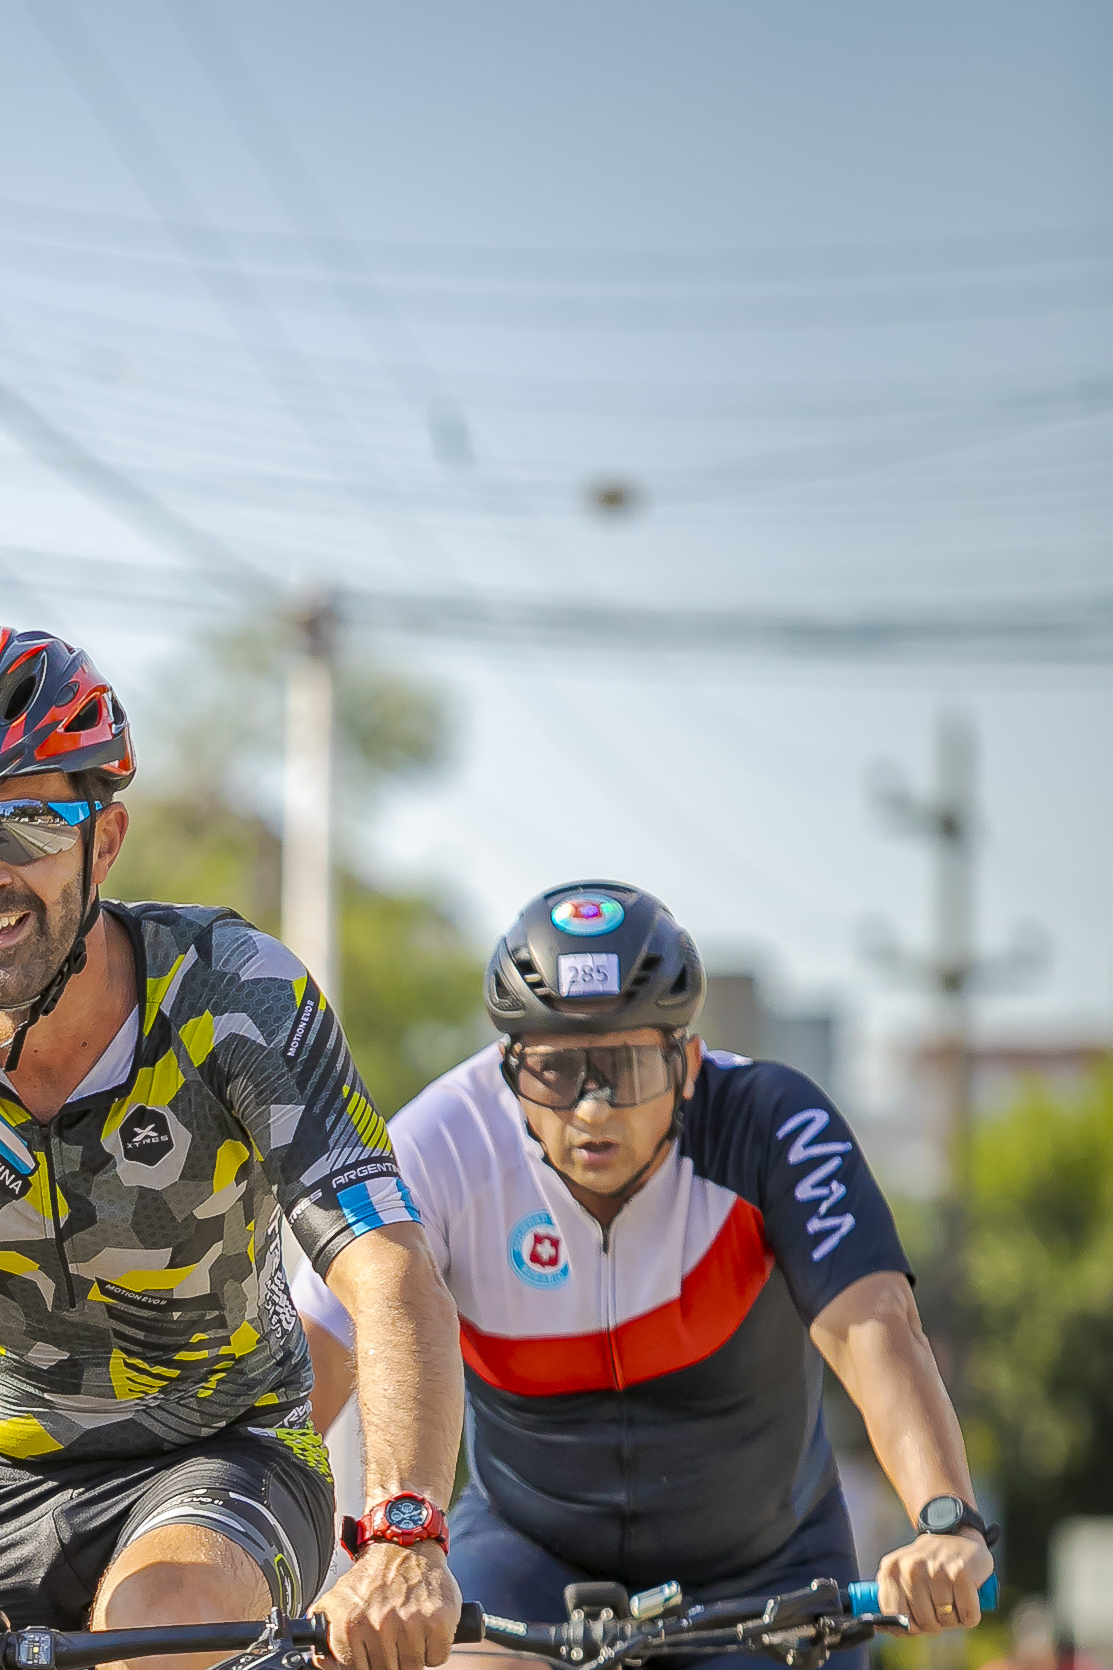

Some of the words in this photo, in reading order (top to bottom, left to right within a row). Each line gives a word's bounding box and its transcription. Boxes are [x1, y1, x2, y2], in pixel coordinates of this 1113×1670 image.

[568, 964, 609, 985] 285
[287, 1021, 307, 1057] MOTION
[105, 1284, 142, 1301] MOTION
[141, 1296, 161, 1305] EVO
